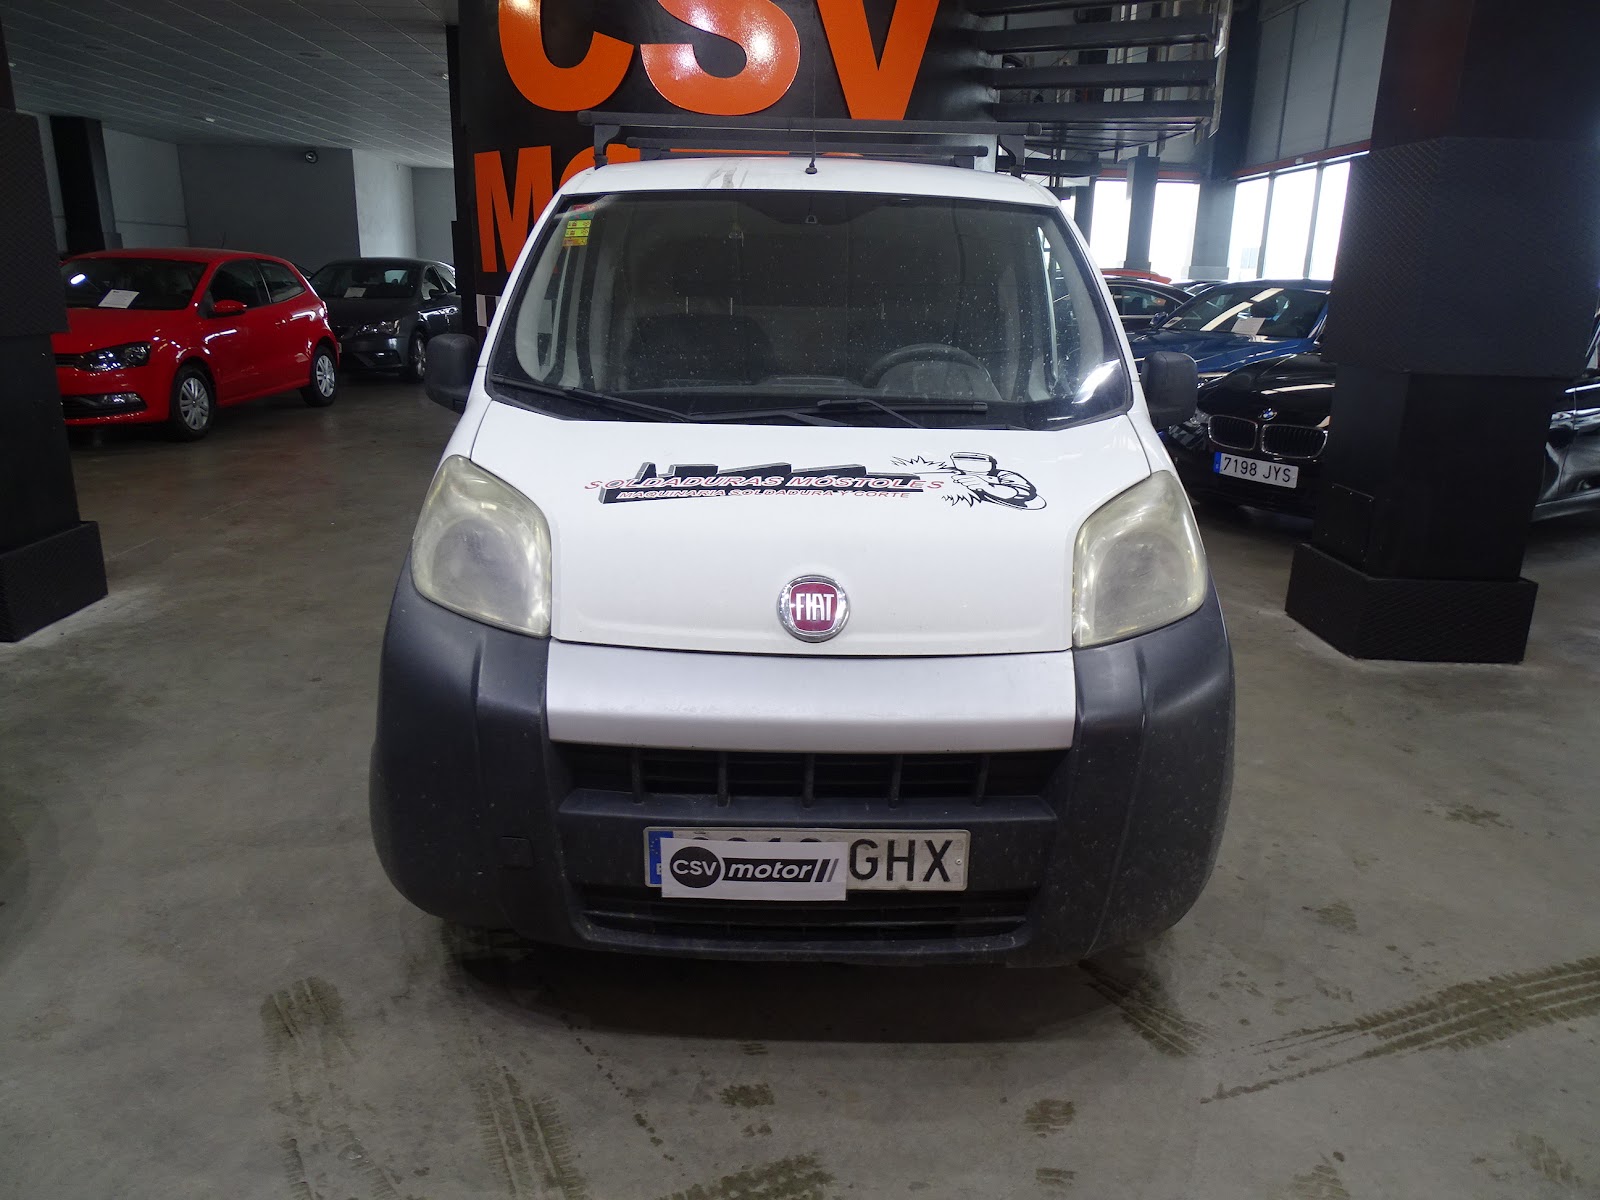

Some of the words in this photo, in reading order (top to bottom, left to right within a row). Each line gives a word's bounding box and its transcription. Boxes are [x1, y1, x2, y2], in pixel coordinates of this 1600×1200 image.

[498, 0, 939, 121] CSV
[584, 476, 784, 490] SOLDADURAS
[785, 474, 945, 490] MÓSTOLES
[1223, 457, 1257, 477] 7198
[1262, 465, 1291, 483] JYS
[616, 488, 725, 499] MAQUINARIA
[727, 488, 833, 496] SOLDADURA
[853, 490, 911, 499] CORTE
[795, 593, 835, 621] FIAT
[672, 859, 718, 876] CSV
[727, 862, 812, 880] motor
[849, 837, 954, 883] GHX
